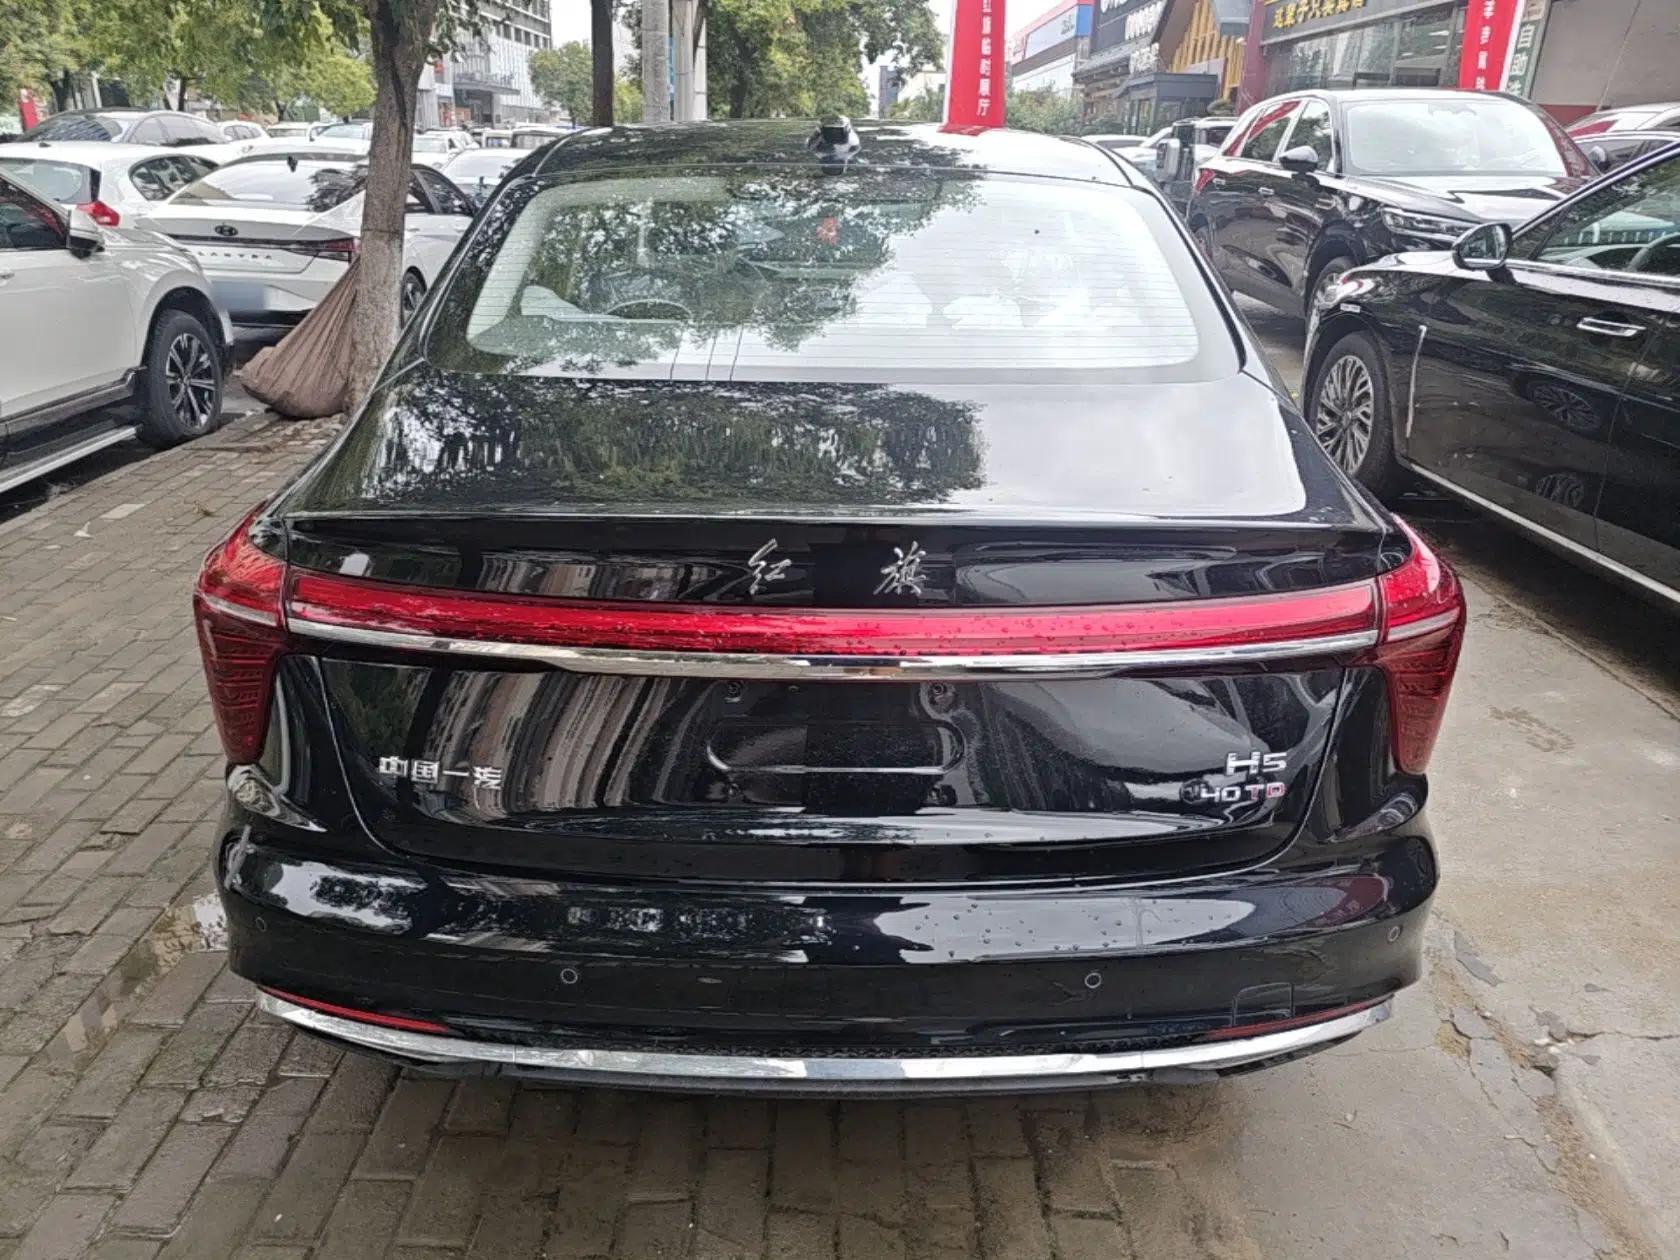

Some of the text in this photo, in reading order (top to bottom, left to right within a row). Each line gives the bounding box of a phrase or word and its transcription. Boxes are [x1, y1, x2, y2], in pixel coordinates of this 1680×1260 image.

[748, 538, 929, 596] 红旗
[379, 755, 502, 790] 中国一汽
[1226, 751, 1288, 776] H5
[1201, 781, 1287, 802] 40TD
